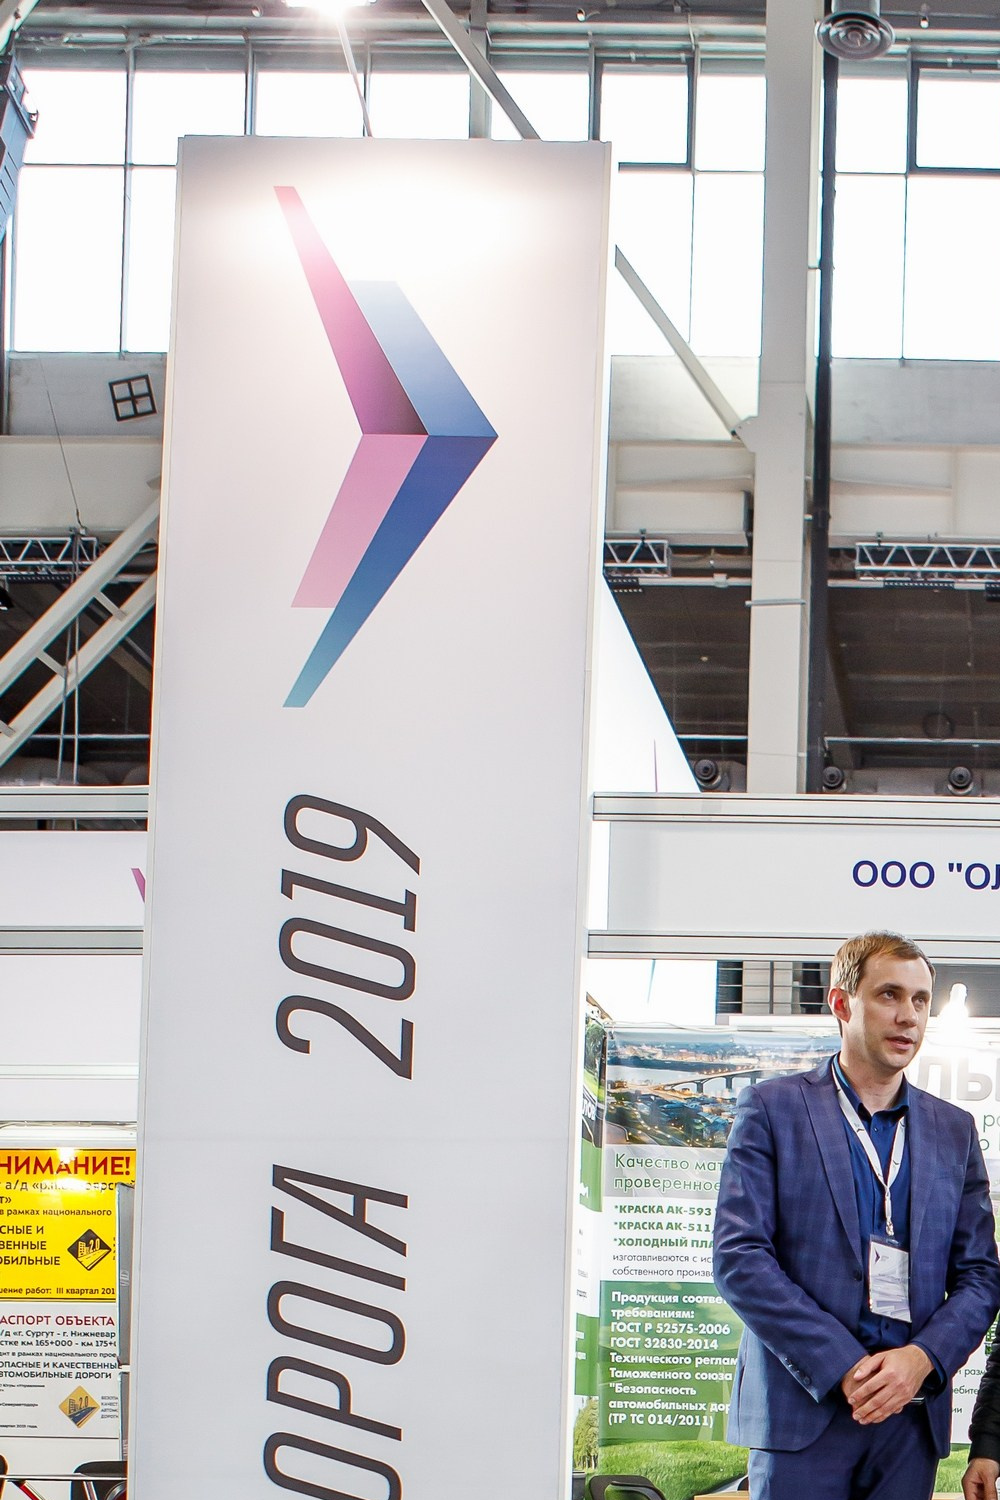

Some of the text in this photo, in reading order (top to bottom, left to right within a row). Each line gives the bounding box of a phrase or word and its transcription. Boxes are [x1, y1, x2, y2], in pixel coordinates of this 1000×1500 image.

[852, 860, 935, 888] ООО
[276, 794, 420, 1080] 2019
[615, 1153, 689, 1169] Качество
[5, 1180, 28, 1191] а/д
[614, 1178, 720, 1191] проверенное
[667, 1206, 711, 1216] АК-593
[36, 1226, 44, 1234] И
[612, 1254, 689, 1263] изготавливаются
[612, 1265, 674, 1276] собственного
[25, 1286, 51, 1297] работ:
[66, 1288, 99, 1296] квартал
[611, 1291, 727, 1305] Продукция соотве
[611, 1308, 694, 1320] требованиям:
[55, 1316, 115, 1326] ОБЪЕКТА
[25, 1330, 54, 1338] Сургут
[611, 1322, 641, 1333] ГОСТ
[656, 1323, 731, 1335] 52575-2006
[610, 1337, 719, 1350] ГОСТ 32830-2014
[609, 1352, 692, 1364] Технического
[609, 1367, 733, 1381] Таможенного союза
[609, 1383, 697, 1395] "Безопасность
[608, 1399, 707, 1411] автомобильных
[608, 1413, 714, 1428] (ТР ТС 014/2011)
